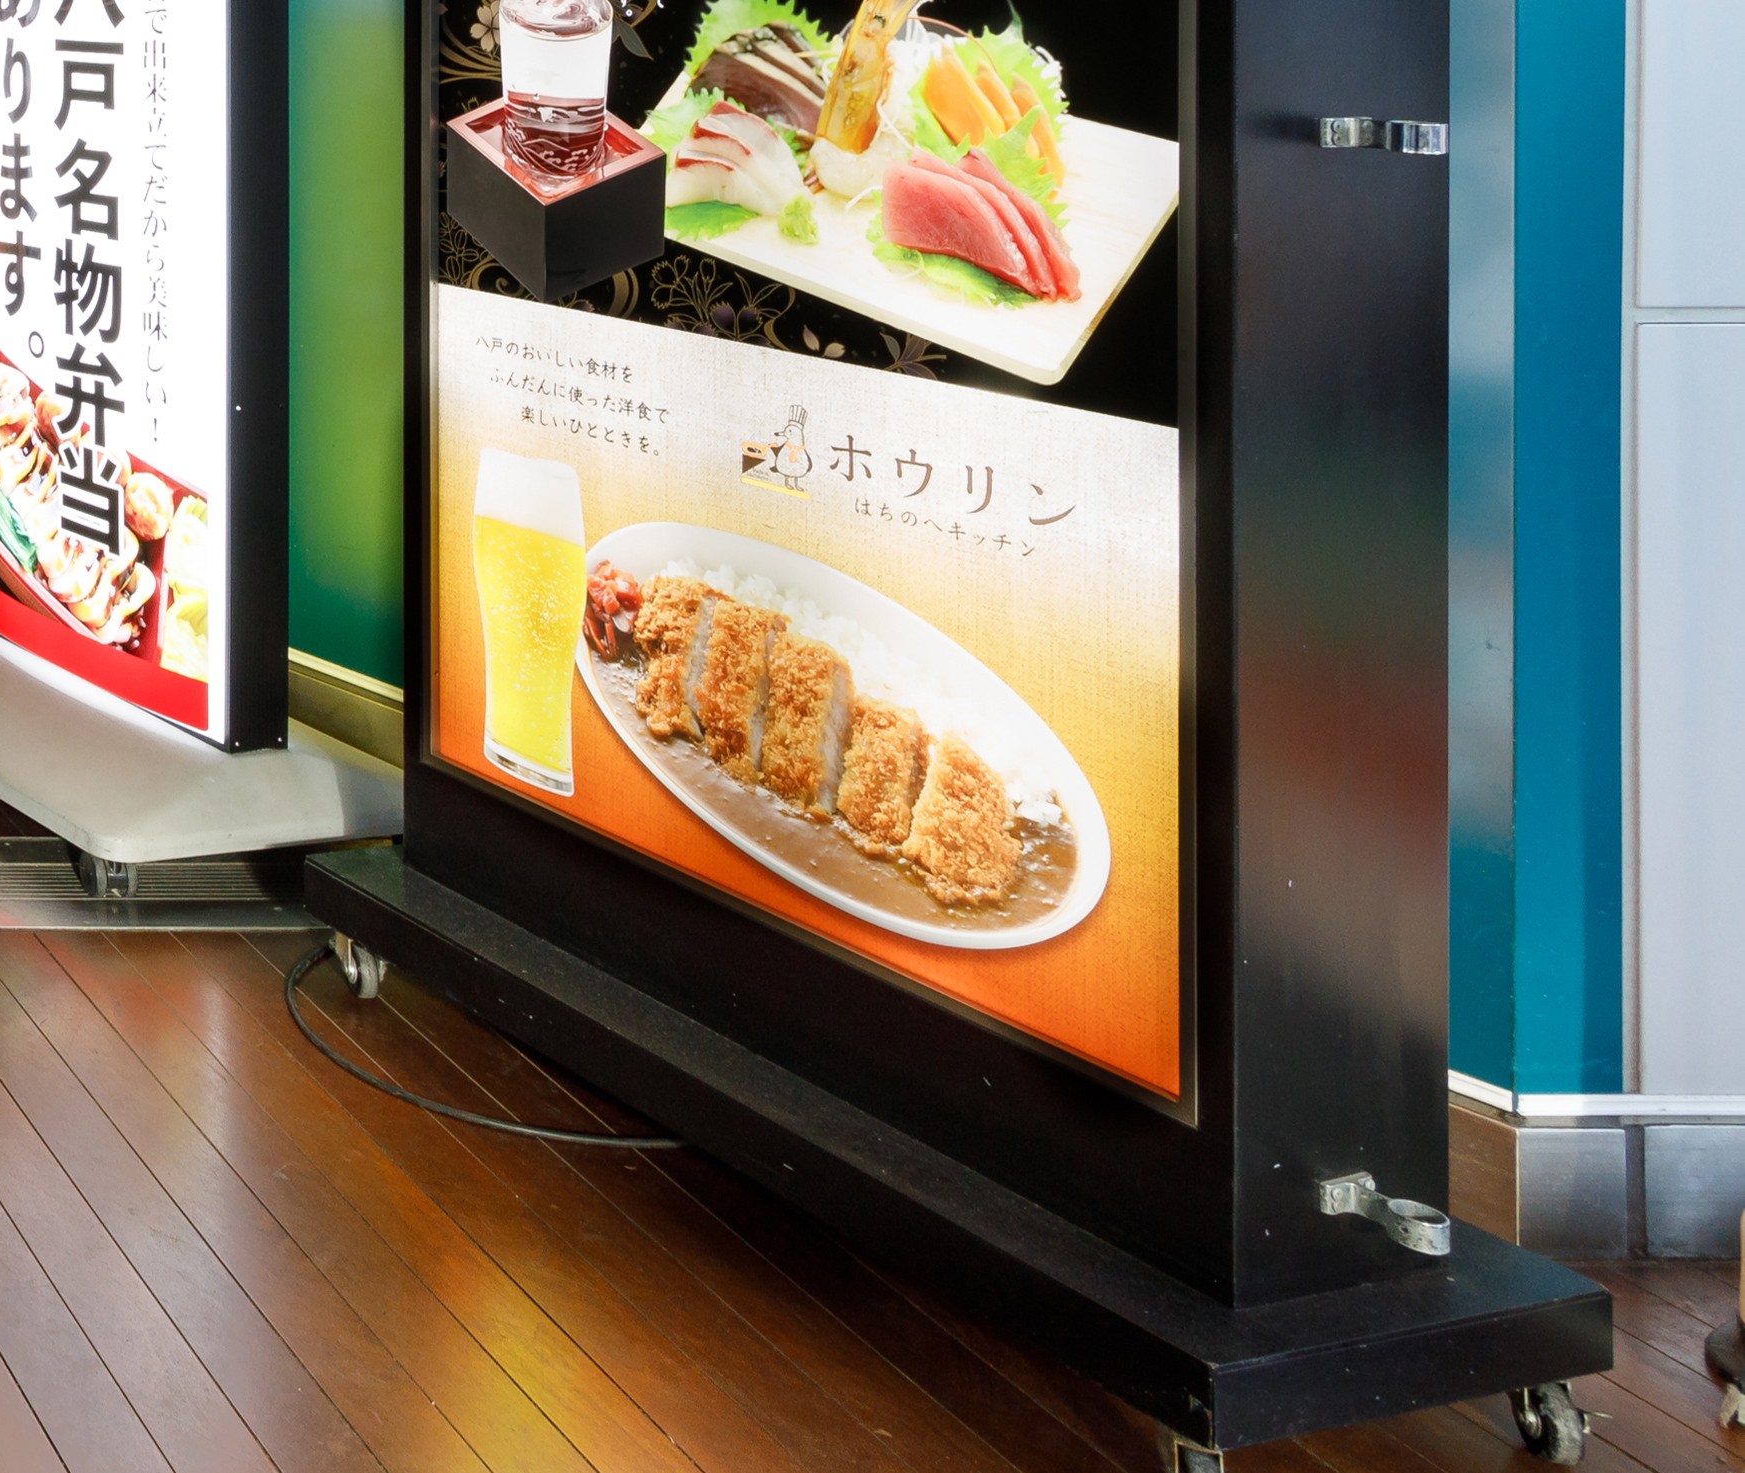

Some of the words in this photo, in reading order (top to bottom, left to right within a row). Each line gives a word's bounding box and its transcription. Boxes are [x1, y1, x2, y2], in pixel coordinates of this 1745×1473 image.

[474, 336, 634, 383] 八戸のおいしい食材を
[490, 373, 670, 425] ふんだんに使った洋食で
[520, 405, 661, 458] 楽しいひとときを。
[830, 434, 1077, 527] ホウリン
